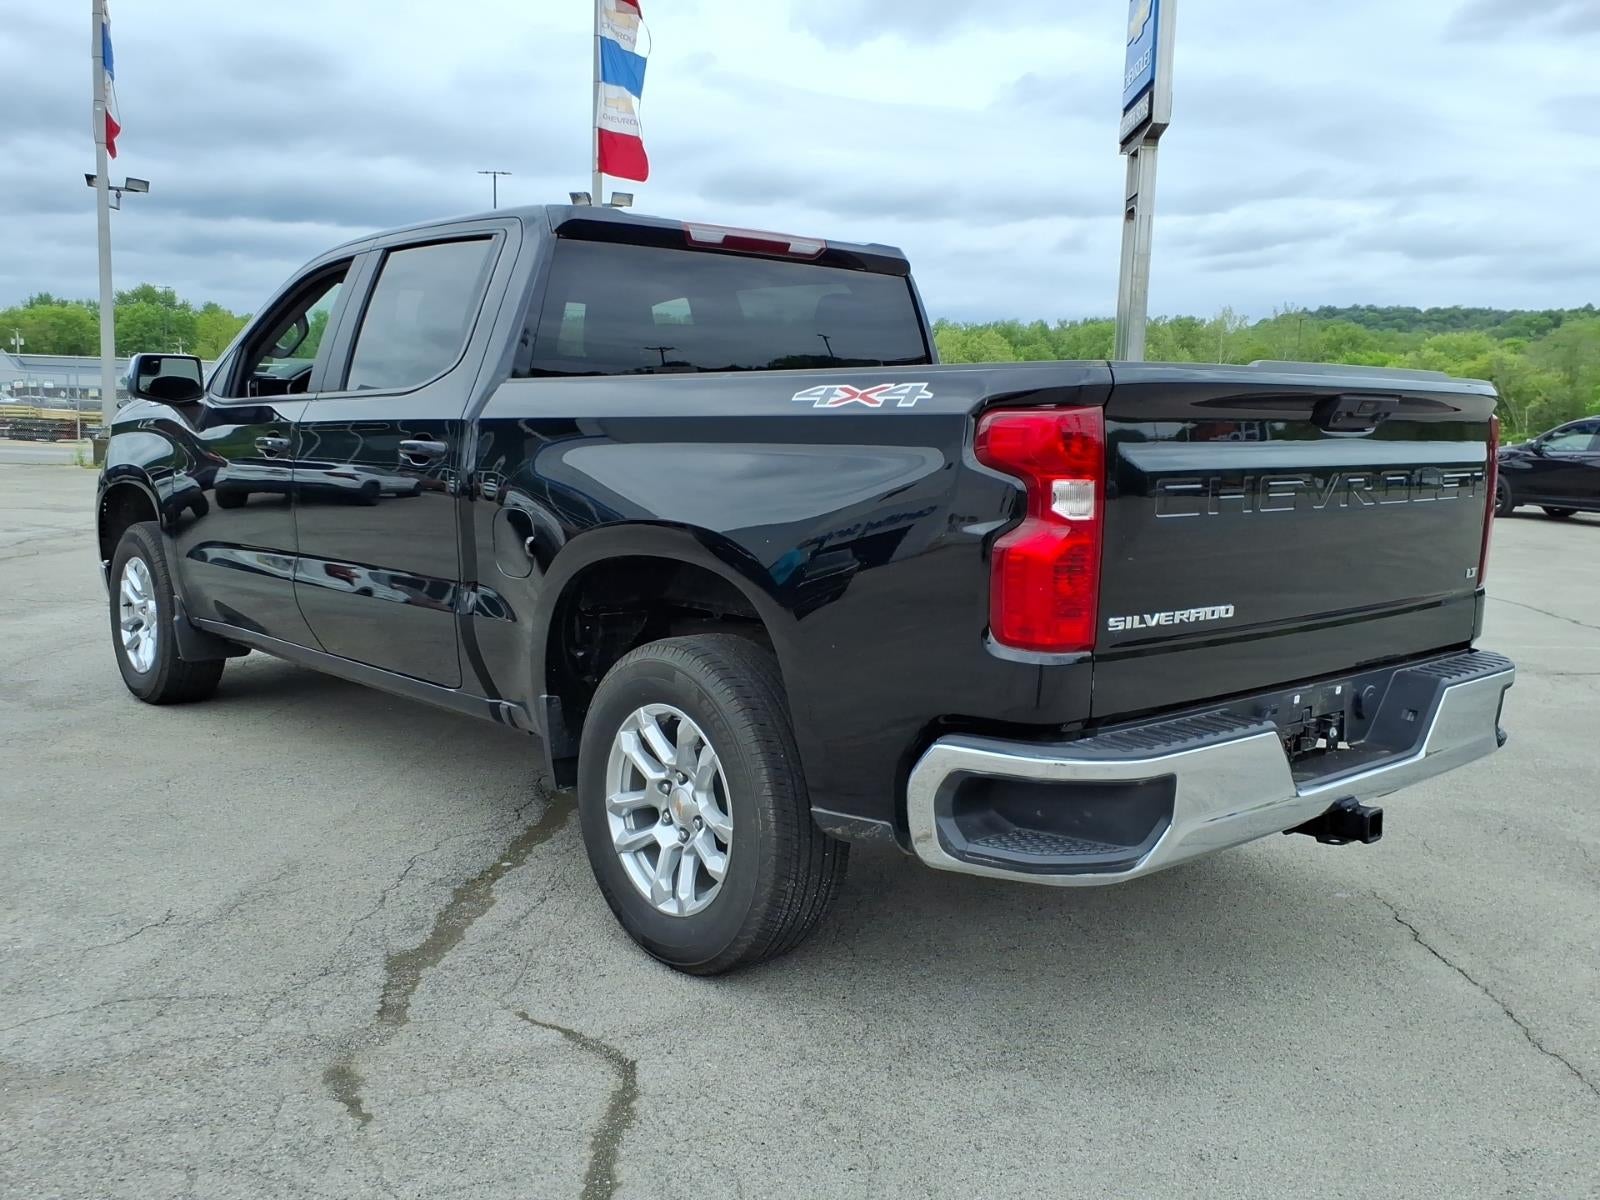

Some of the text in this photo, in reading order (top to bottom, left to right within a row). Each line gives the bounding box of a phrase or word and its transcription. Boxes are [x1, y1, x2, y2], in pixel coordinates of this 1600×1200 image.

[1154, 470, 1484, 518] CHEVROLET
[1465, 567, 1478, 579] LT
[1107, 604, 1235, 632] SILVERADO
